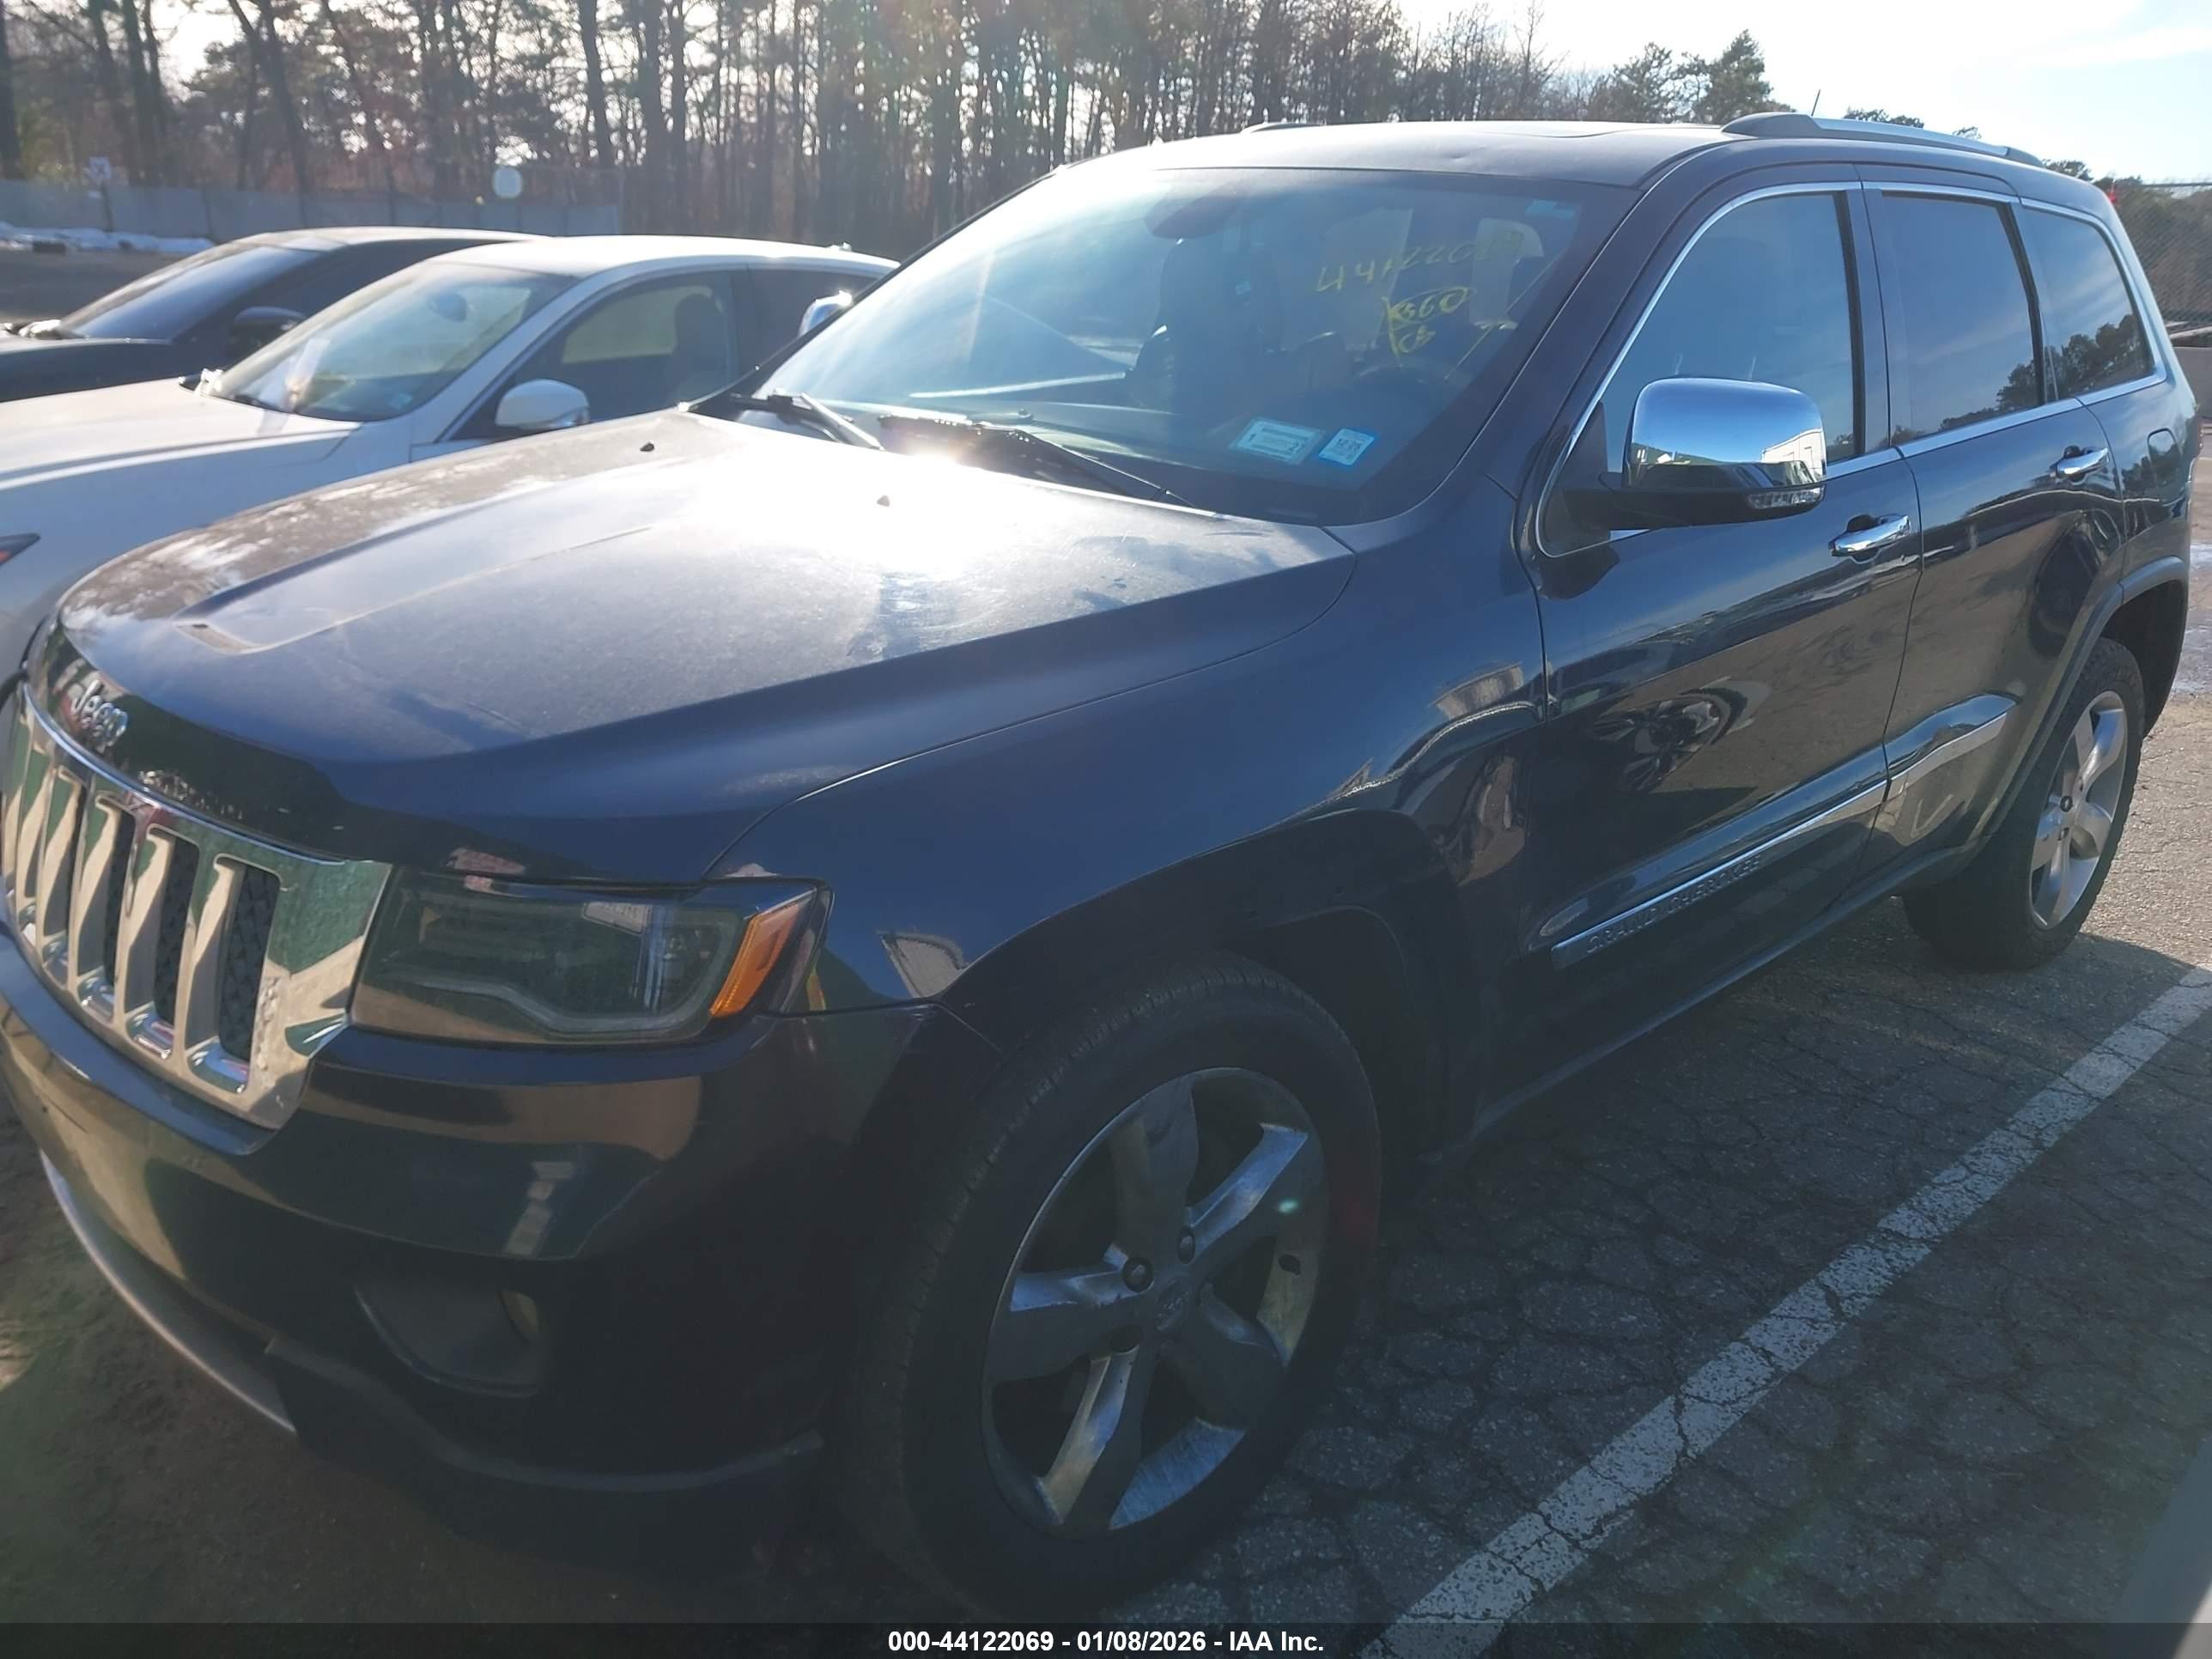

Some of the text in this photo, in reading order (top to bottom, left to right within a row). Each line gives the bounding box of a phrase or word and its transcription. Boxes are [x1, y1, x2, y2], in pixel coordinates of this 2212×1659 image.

[71, 679, 128, 743] Jeep
[1587, 854, 1761, 953] GRAND CHEROKEE
